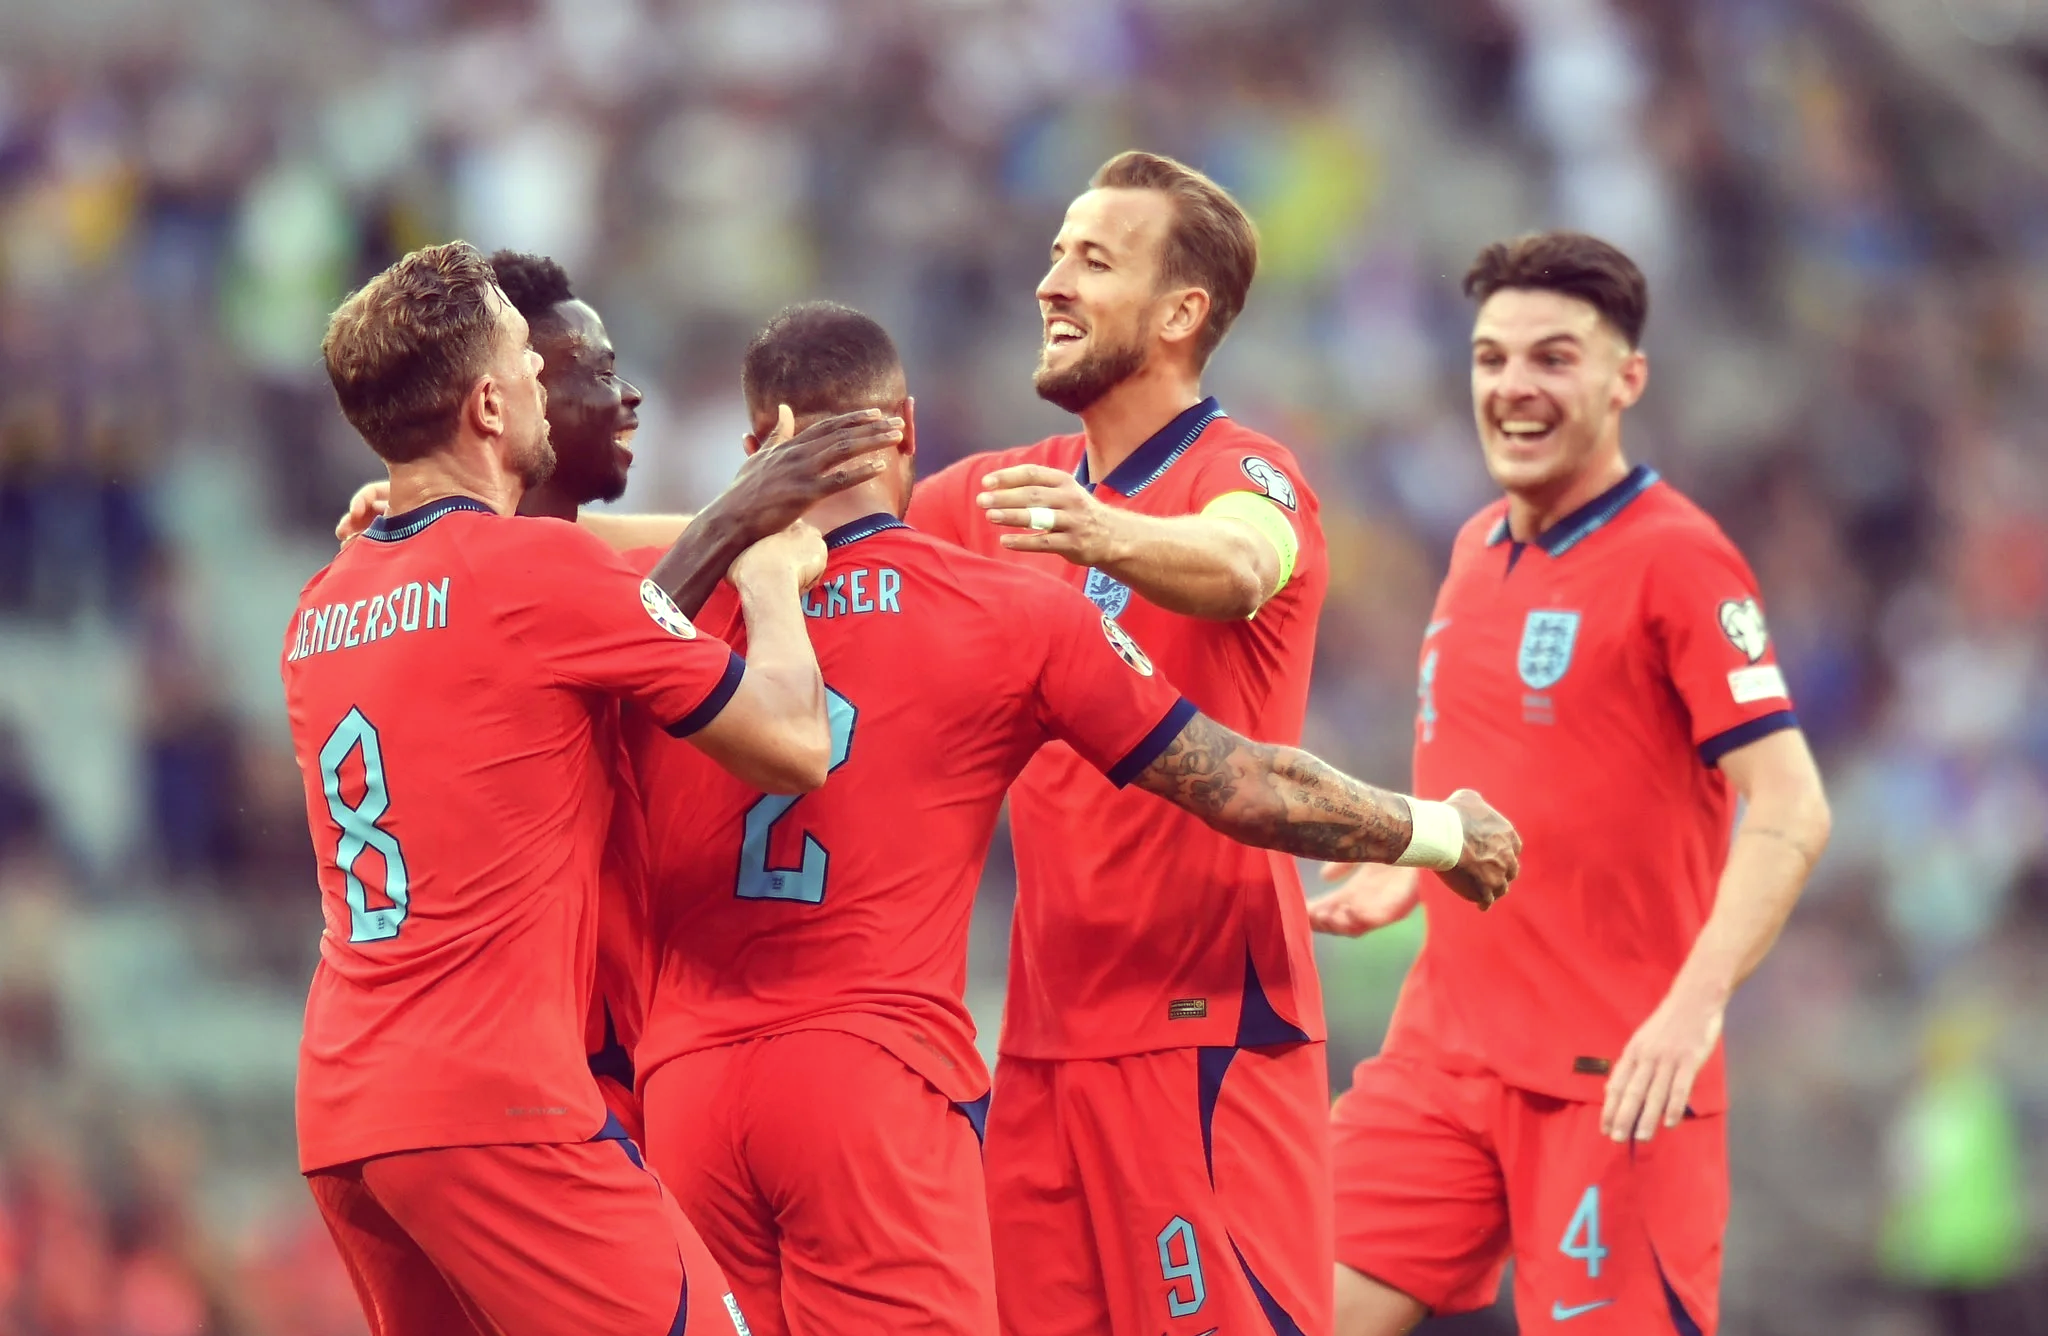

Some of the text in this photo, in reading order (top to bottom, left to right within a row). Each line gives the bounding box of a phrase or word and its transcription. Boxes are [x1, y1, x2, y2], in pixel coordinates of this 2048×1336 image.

[288, 577, 450, 662] HENDERSON
[318, 703, 409, 943] 8
[734, 682, 859, 905] 2
[1156, 1214, 1206, 1319] 9
[1558, 1185, 1609, 1278] 4
